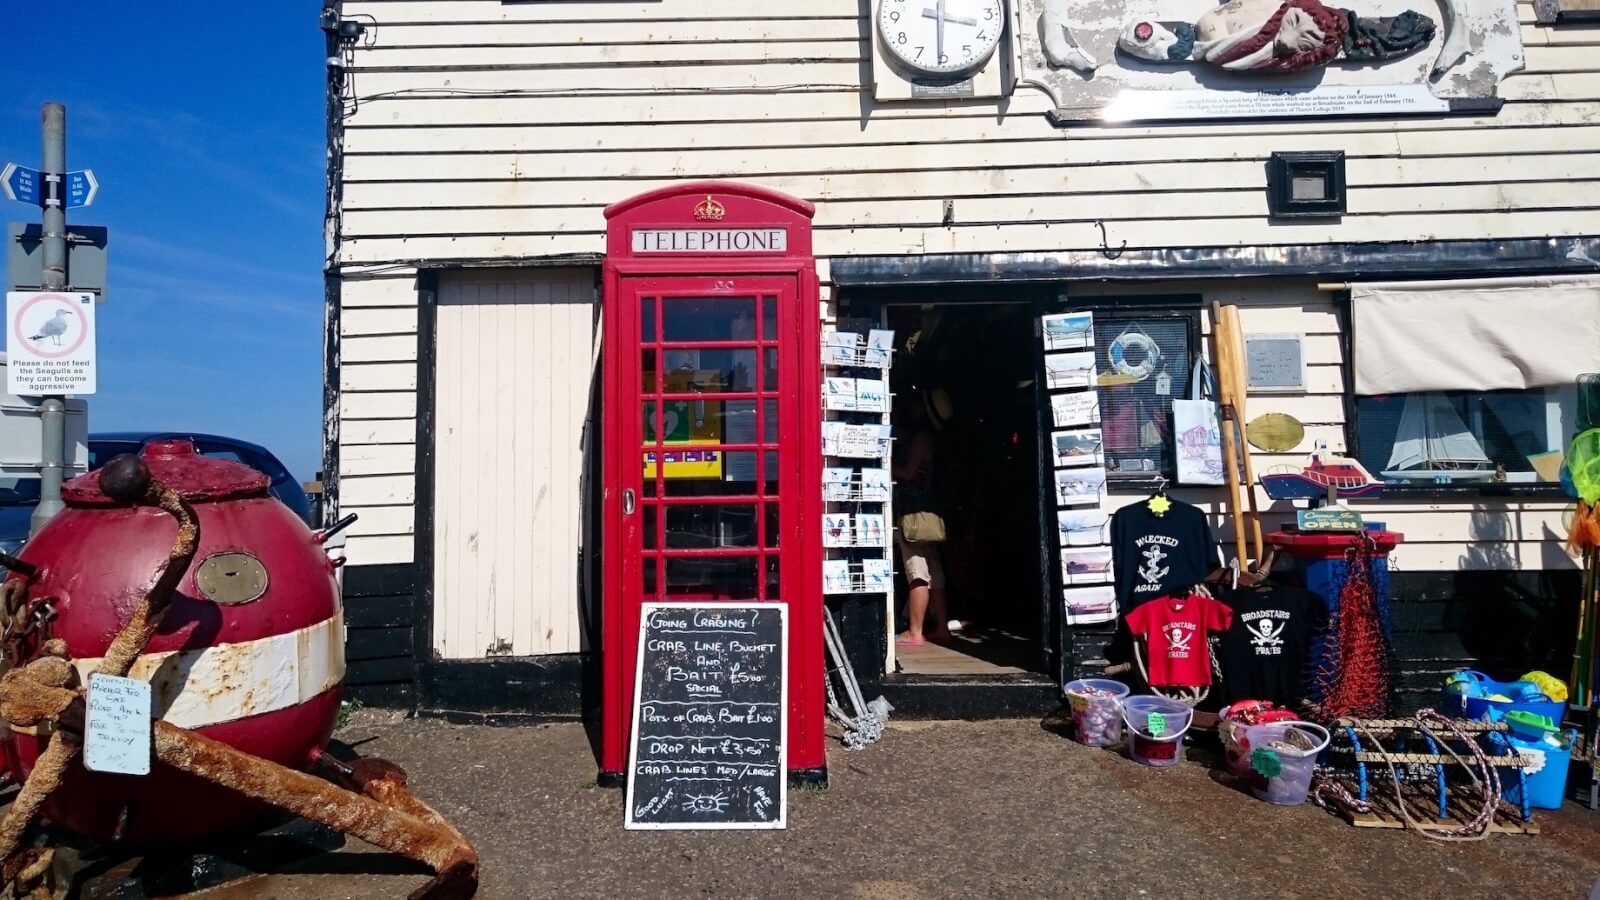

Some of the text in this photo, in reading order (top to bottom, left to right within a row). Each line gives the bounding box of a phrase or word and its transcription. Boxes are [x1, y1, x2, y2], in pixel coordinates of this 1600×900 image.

[638, 231, 781, 250] TELEPHONE
[1135, 535, 1179, 547] WRECKED
[1134, 584, 1162, 592] AGAIN
[650, 612, 687, 629] GOING
[1241, 610, 1290, 622] BROADSTAIRS
[648, 639, 686, 652] CRAB
[730, 640, 776, 652] BUCKET
[1255, 646, 1281, 655] PIRATES
[697, 656, 720, 666] AND
[668, 666, 723, 682] BAIT
[686, 684, 722, 693] SPECIAL
[686, 708, 715, 723] CRAB
[719, 708, 745, 723] BAIT
[650, 743, 684, 754] DROP
[691, 743, 717, 754] NET
[637, 765, 671, 775] CRAB
[676, 766, 707, 775] LINES
[635, 796, 659, 817] GOOD
